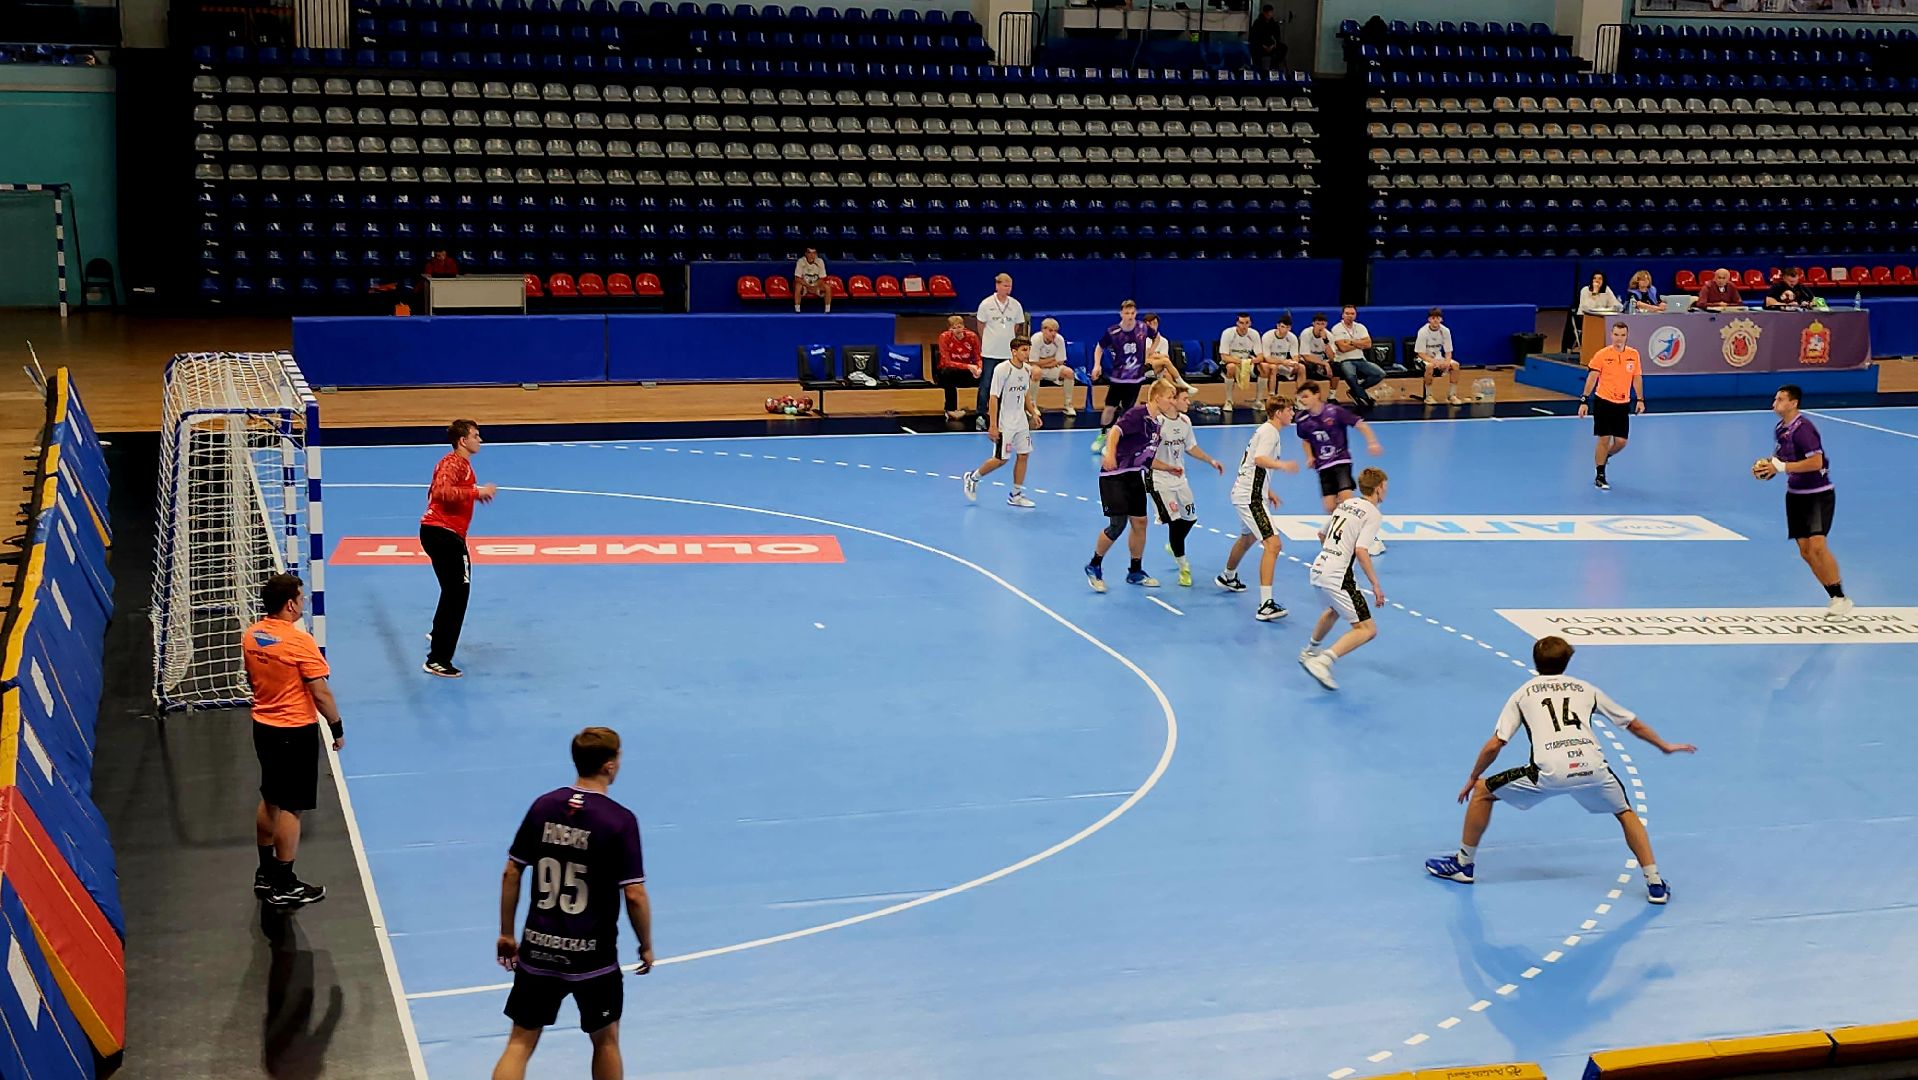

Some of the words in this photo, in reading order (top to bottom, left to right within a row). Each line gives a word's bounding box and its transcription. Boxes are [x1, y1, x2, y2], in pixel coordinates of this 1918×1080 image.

[1328, 515, 1347, 544] 14
[356, 543, 820, 557] OLIMPBT
[1541, 697, 1582, 732] 14
[536, 856, 590, 915] 95
